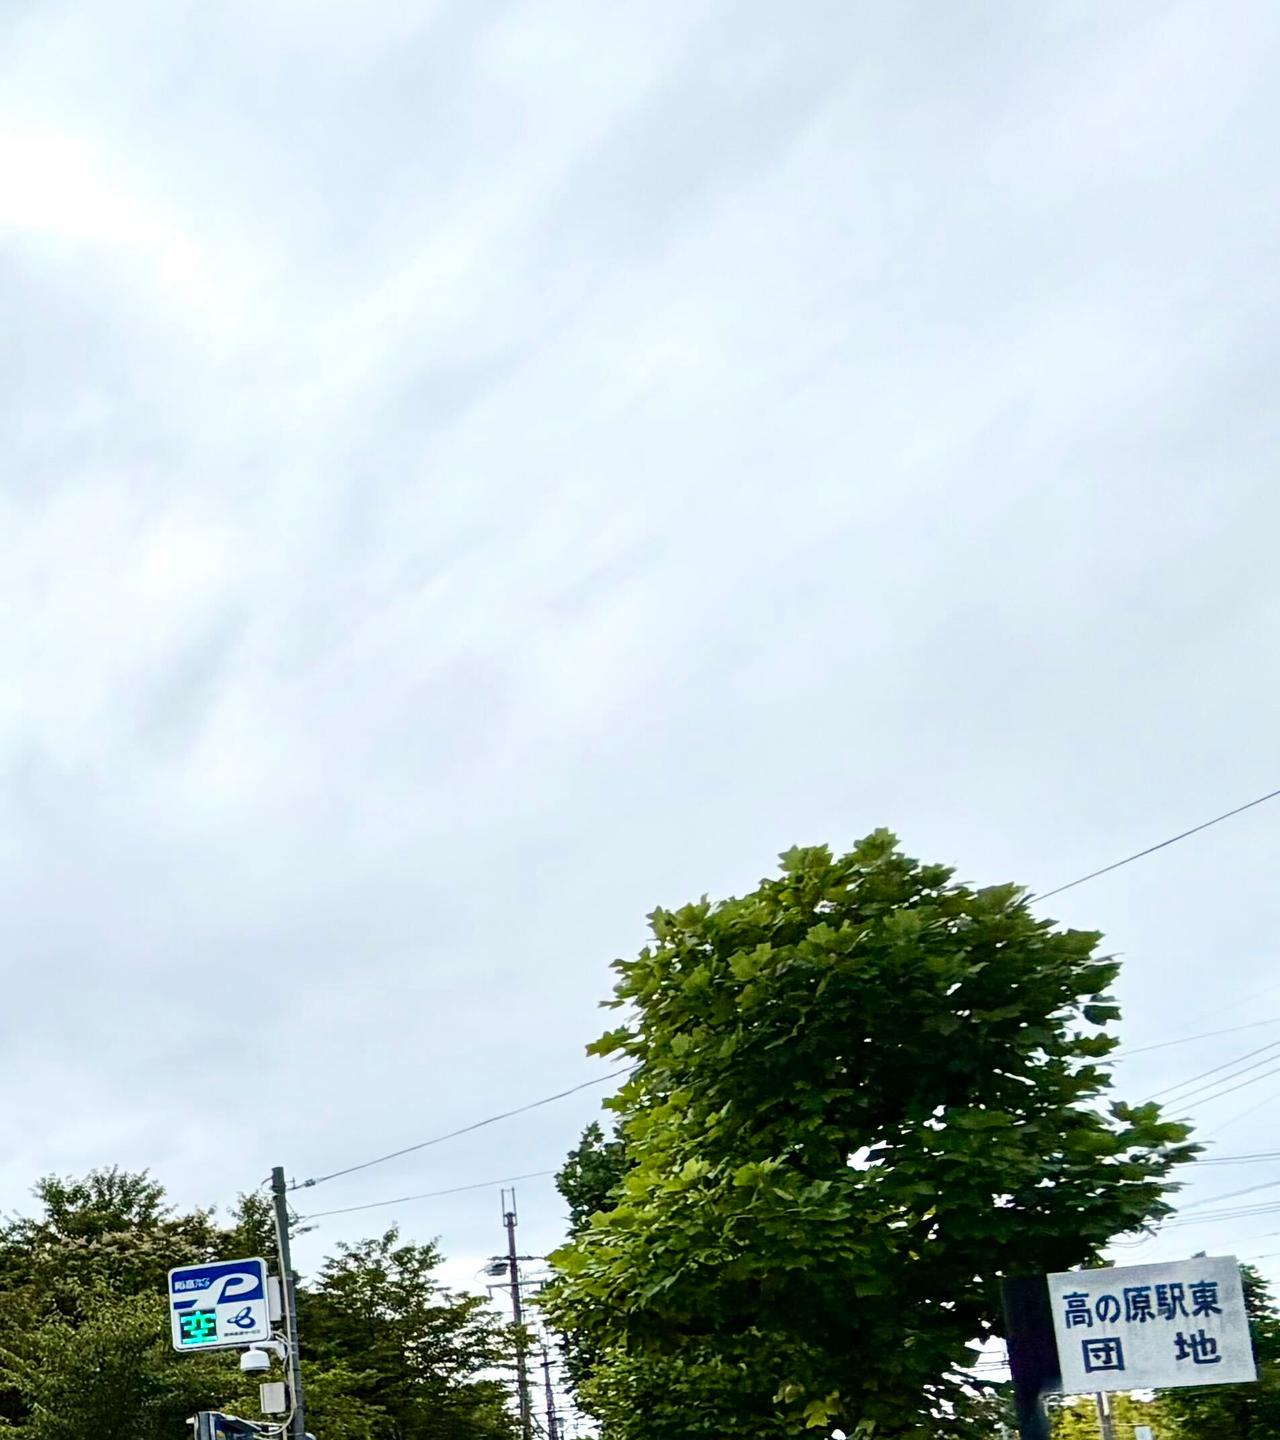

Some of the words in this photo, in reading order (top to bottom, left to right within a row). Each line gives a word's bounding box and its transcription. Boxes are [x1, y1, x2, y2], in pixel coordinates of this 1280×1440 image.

[1062, 1280, 1223, 1329] 高の原駅東
[180, 1311, 218, 1344] 空
